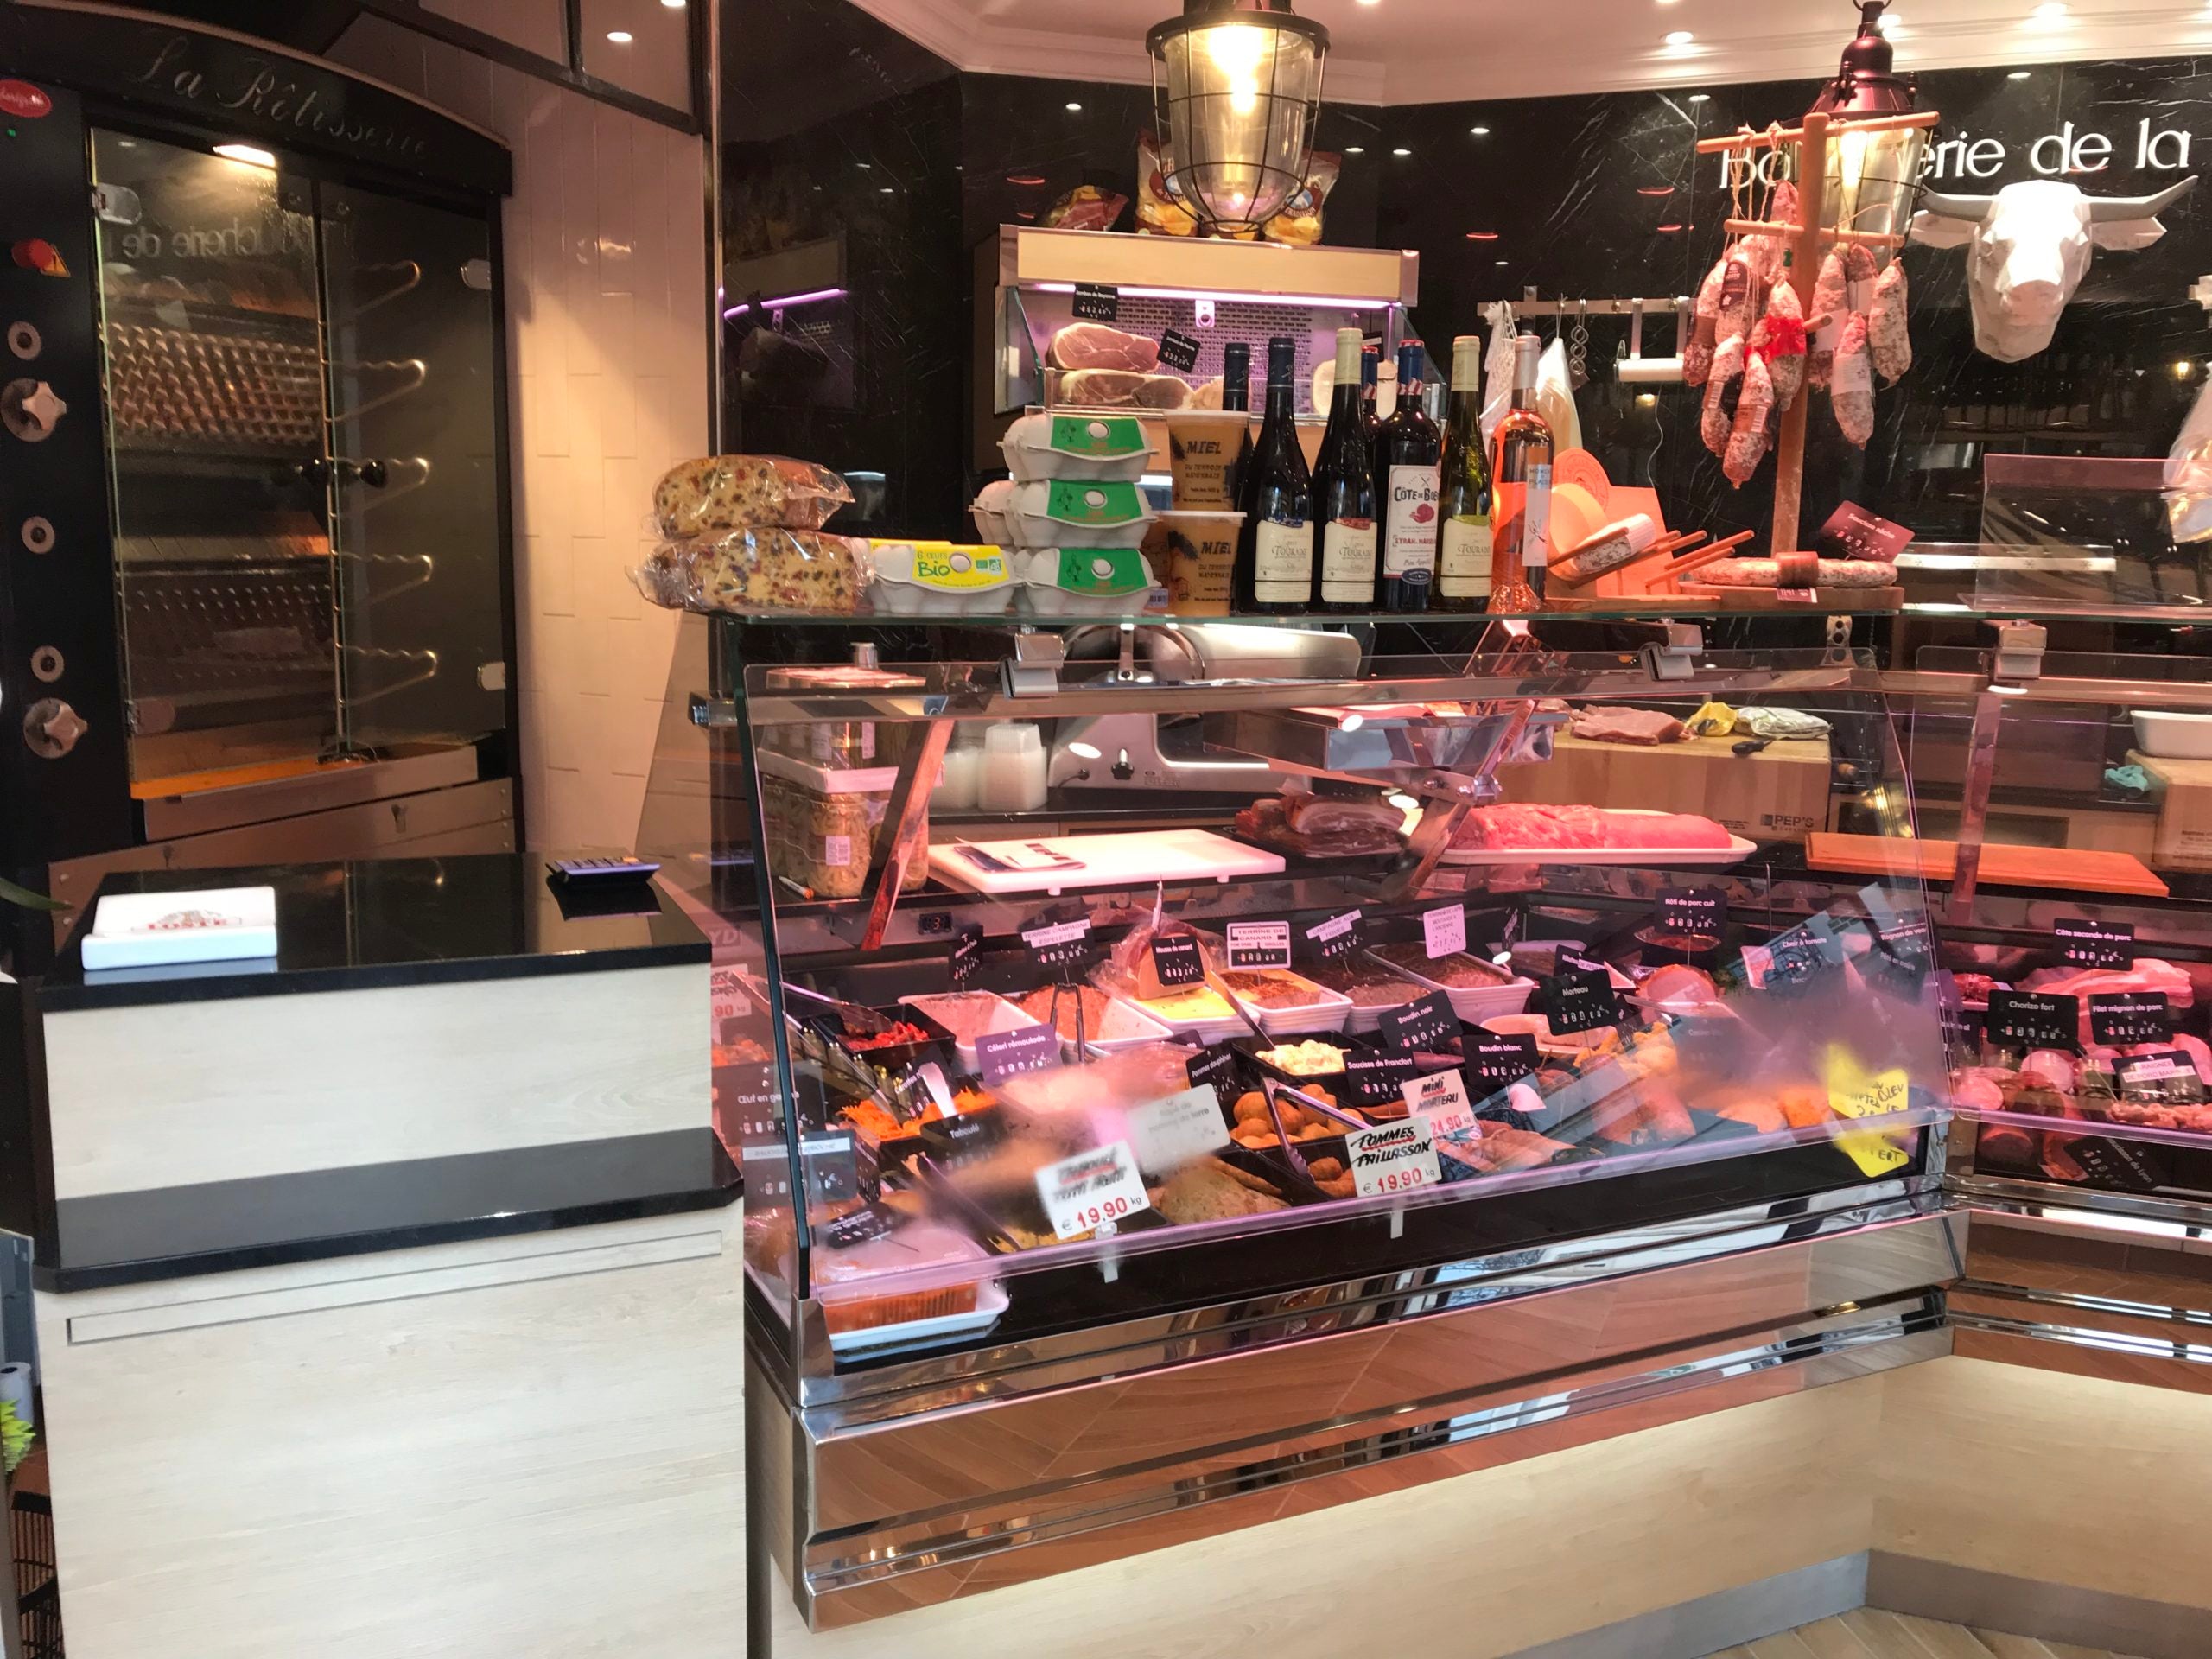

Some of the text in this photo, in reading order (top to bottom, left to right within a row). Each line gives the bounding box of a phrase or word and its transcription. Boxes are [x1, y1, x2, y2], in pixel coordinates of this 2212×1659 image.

[126, 35, 202, 99] La
[2030, 121, 2113, 174] de
[2140, 118, 2190, 169] la
[1186, 441, 1222, 454] MIEL
[1394, 486, 1418, 502] CÔTE
[1201, 542, 1231, 555] MIEL
[918, 560, 950, 577] Bio
[1774, 814, 1815, 828] PEP'S
[933, 916, 940, 930] 3
[1561, 987, 1589, 996] Morteau
[2008, 1001, 2039, 1009] Chorizo
[1397, 1005, 1433, 1025] Boudin noir
[1351, 1127, 1415, 1148] POMMES
[1130, 1196, 1142, 1205] kg
